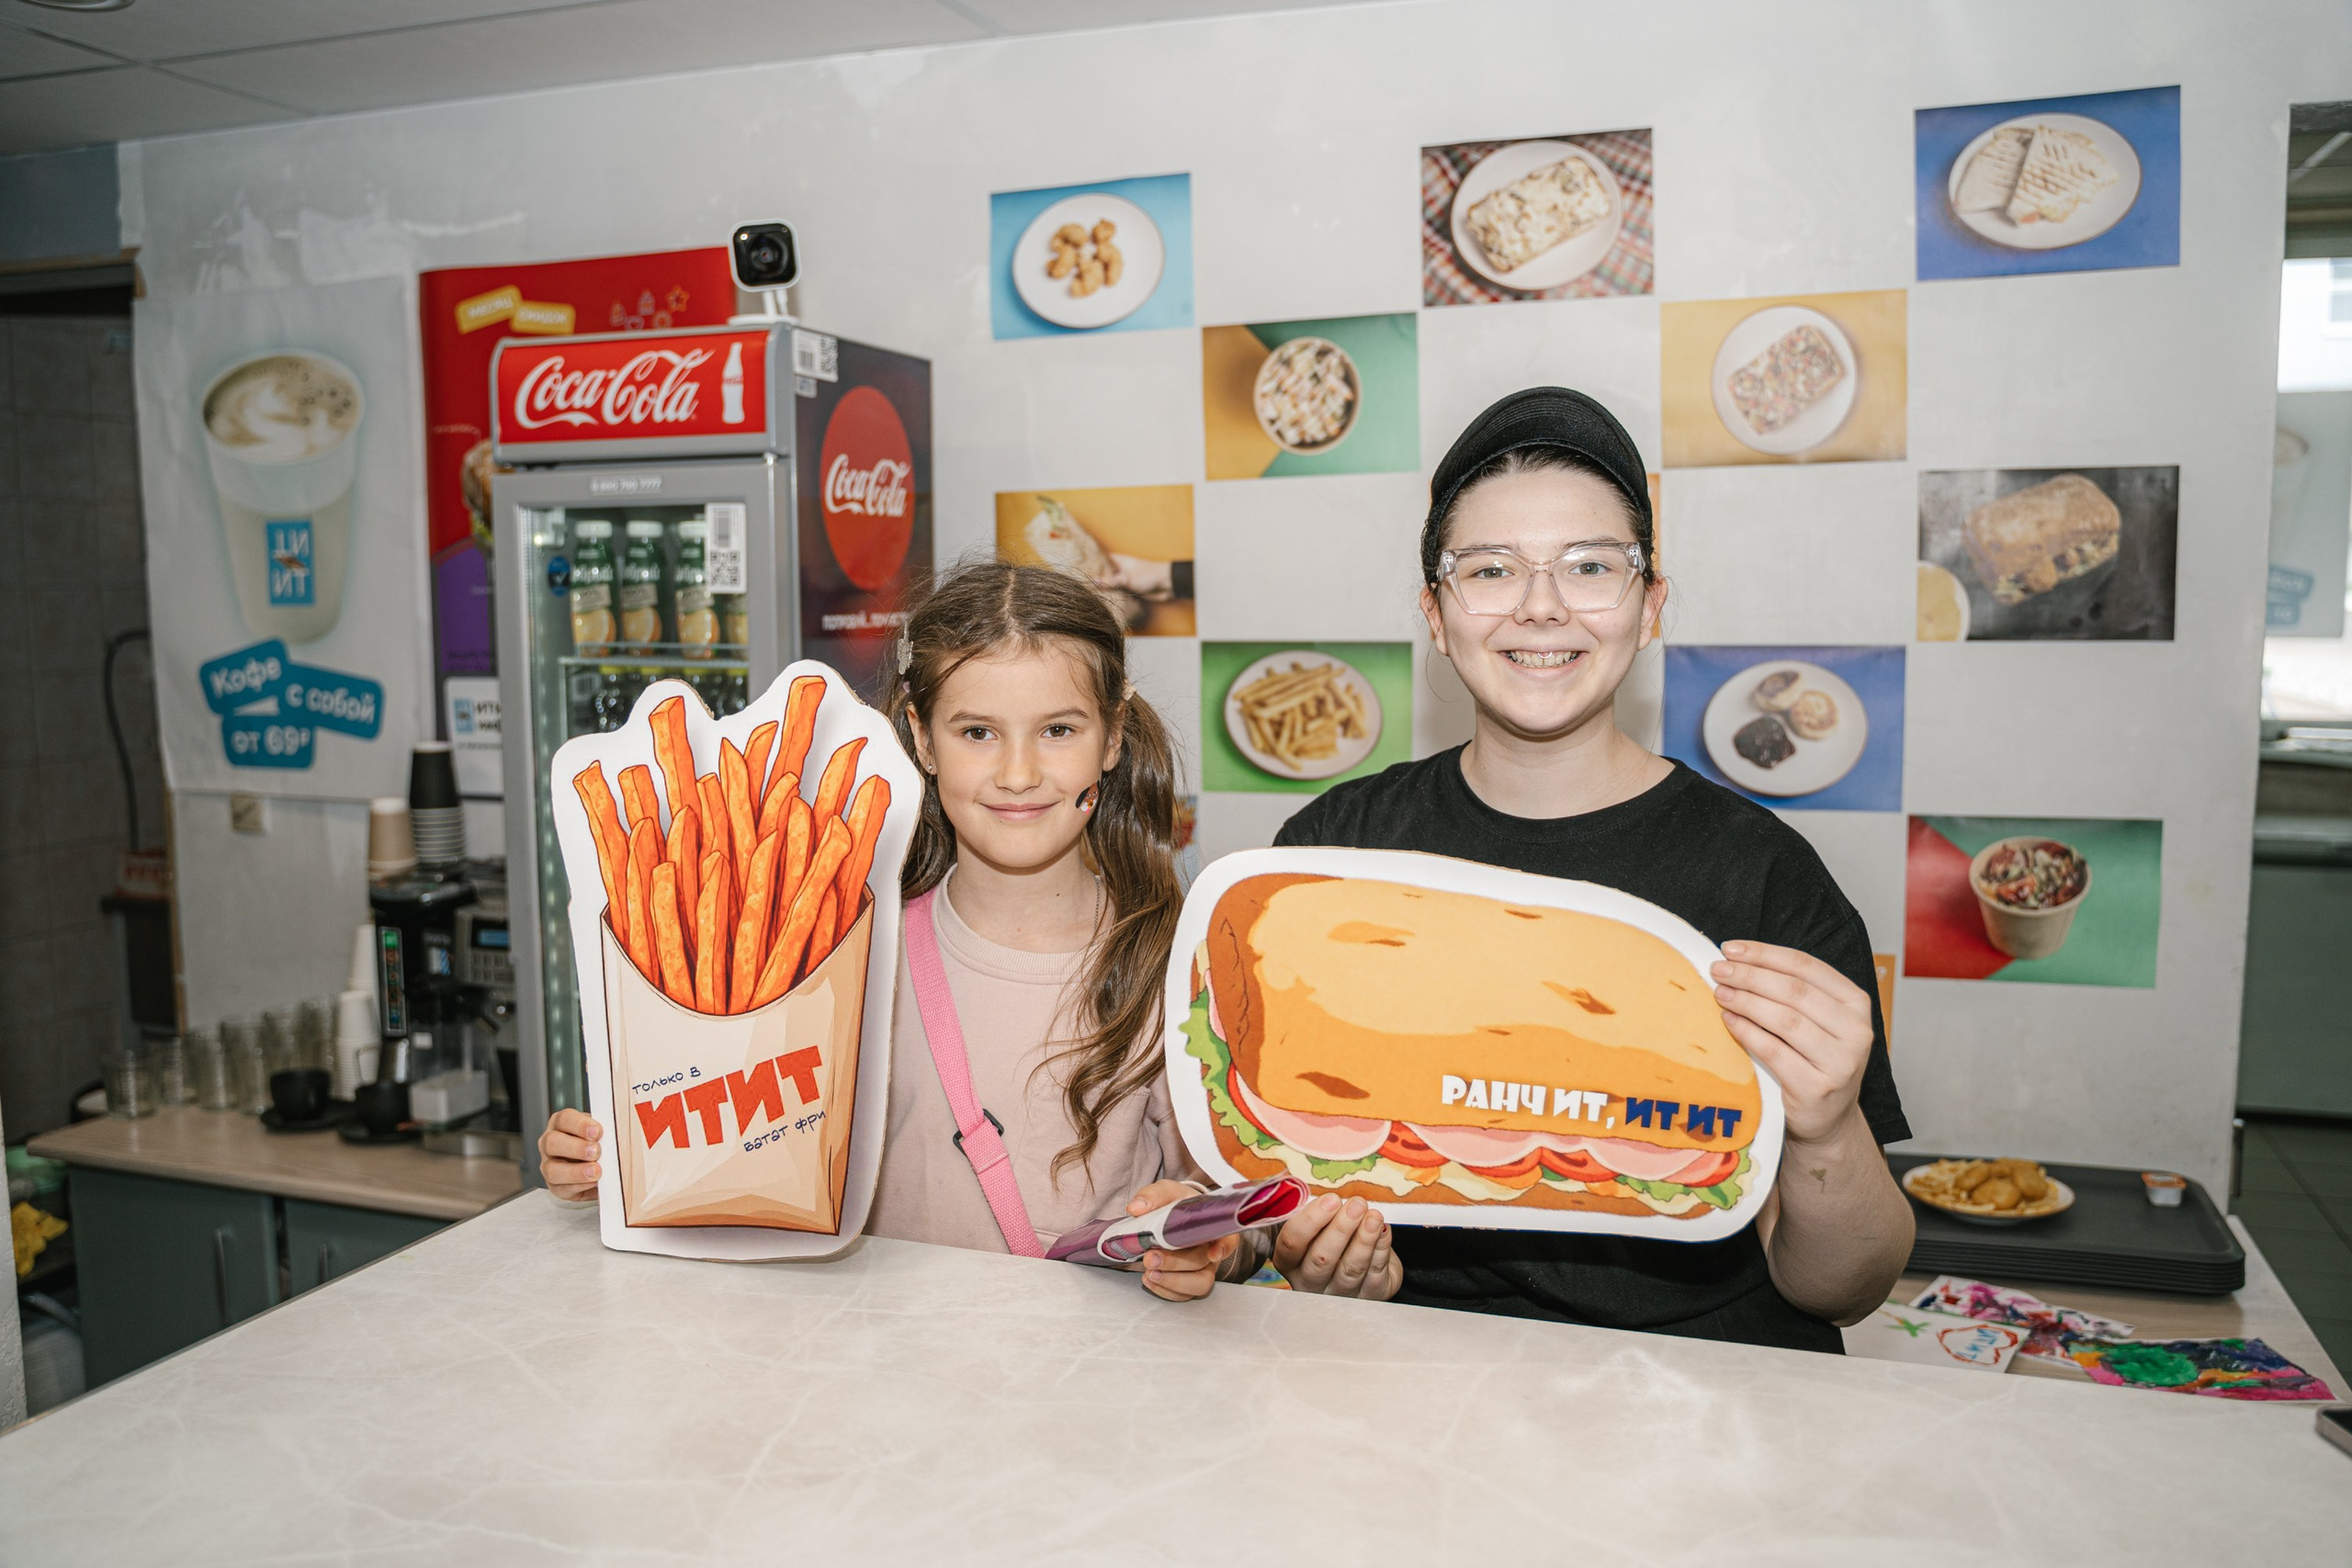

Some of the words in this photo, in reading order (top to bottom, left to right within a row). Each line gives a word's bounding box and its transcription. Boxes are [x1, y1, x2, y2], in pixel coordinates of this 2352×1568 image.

[514, 348, 716, 429] Coca-Cola
[826, 454, 910, 517] Coca-Cola
[210, 657, 282, 698] Кофе
[286, 683, 304, 708] с
[306, 687, 375, 724] собой
[232, 729, 260, 754] от
[795, 1111, 826, 1134] фри
[1441, 1075, 1546, 1116] РАНЧ
[1553, 1088, 1615, 1130] ИТ,
[1625, 1097, 1680, 1131] ИТ
[1687, 1104, 1742, 1138] ИТ
